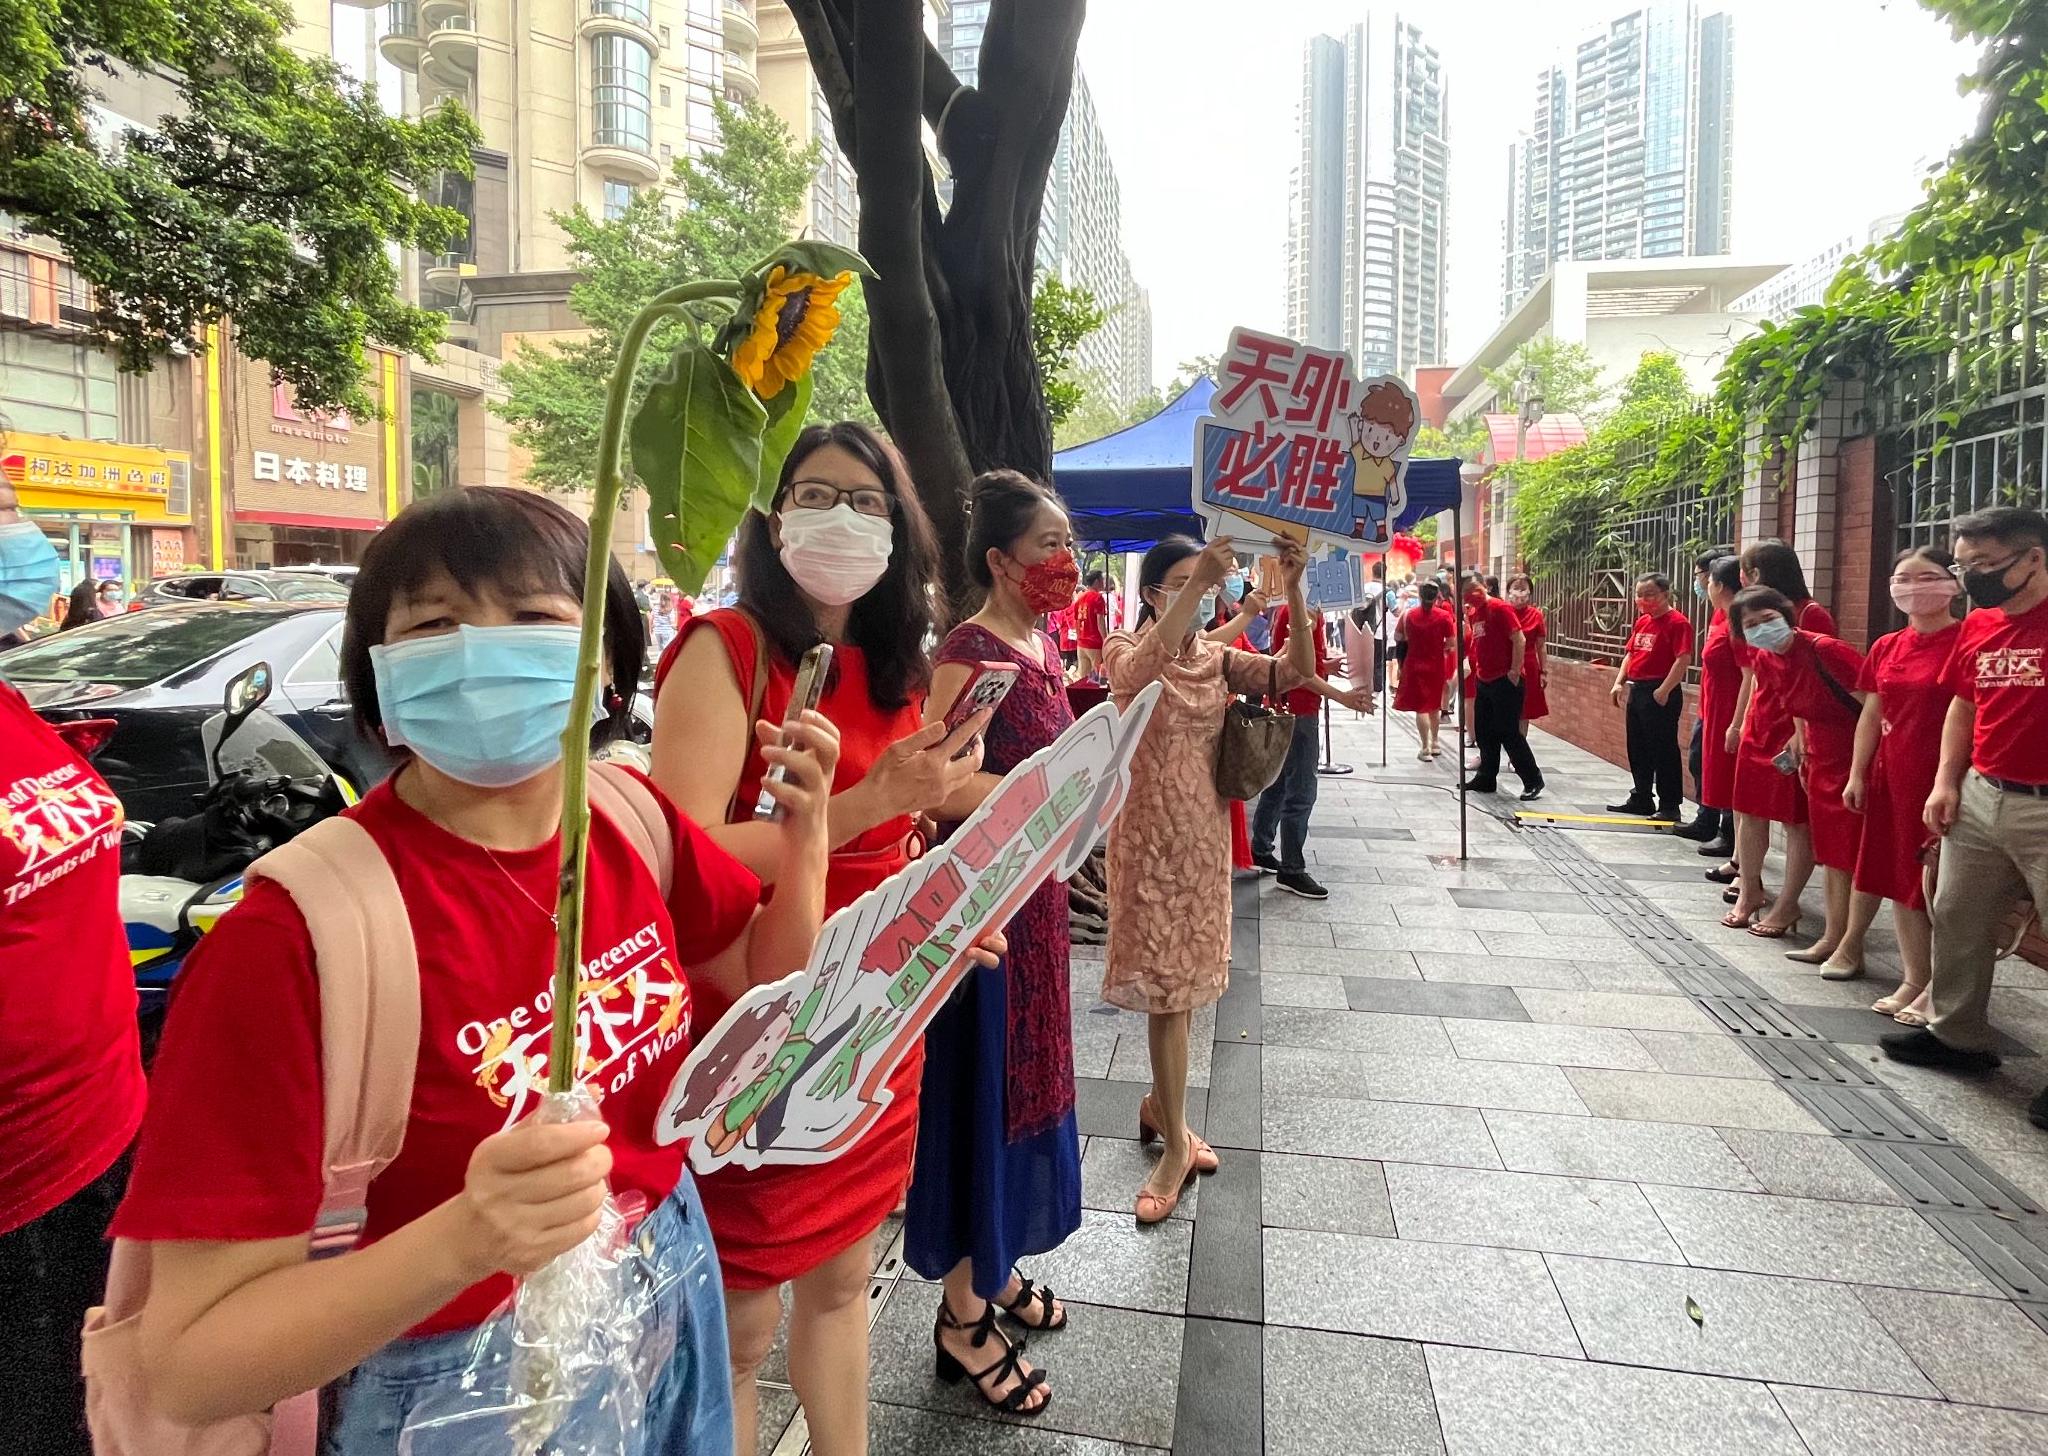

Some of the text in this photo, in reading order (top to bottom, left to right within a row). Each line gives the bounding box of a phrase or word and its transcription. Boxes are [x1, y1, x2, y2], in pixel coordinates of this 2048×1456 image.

[1219, 333, 1351, 433] 天外
[253, 450, 368, 492] 日本料理
[271, 423, 349, 444] masamoto
[1213, 420, 1348, 512] 必胜
[3, 855, 78, 906] Talents
[79, 837, 101, 864] of
[859, 762, 1051, 976] 加油
[806, 767, 1097, 1101] 天外必胜
[610, 1010, 690, 1095] of Worl
